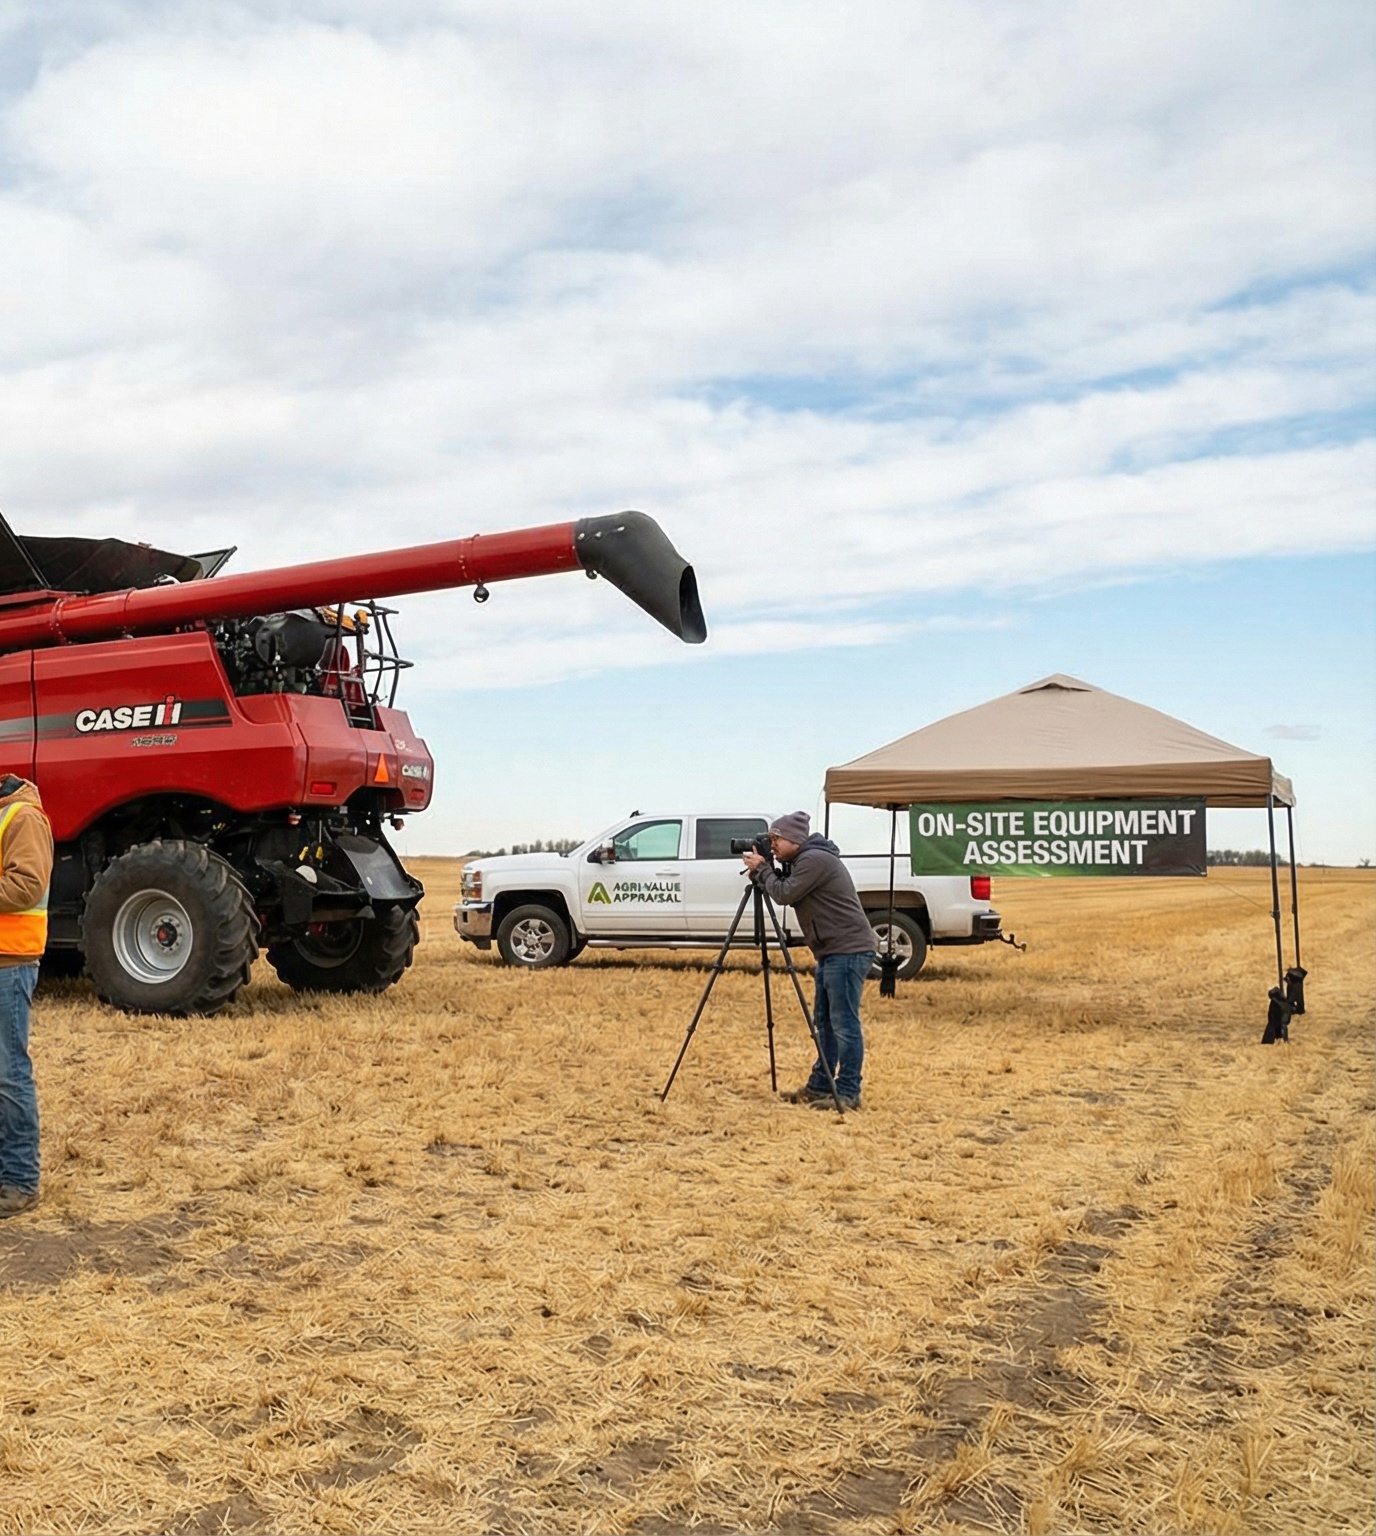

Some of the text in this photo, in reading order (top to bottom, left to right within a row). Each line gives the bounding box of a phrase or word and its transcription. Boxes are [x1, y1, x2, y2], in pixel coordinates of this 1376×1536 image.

[75, 706, 153, 732] CASE
[918, 810, 1196, 837] ON-SITE EQUIPMENT
[963, 840, 1148, 865] ASSESSMENT
[613, 893, 682, 903] APPRAISAL
